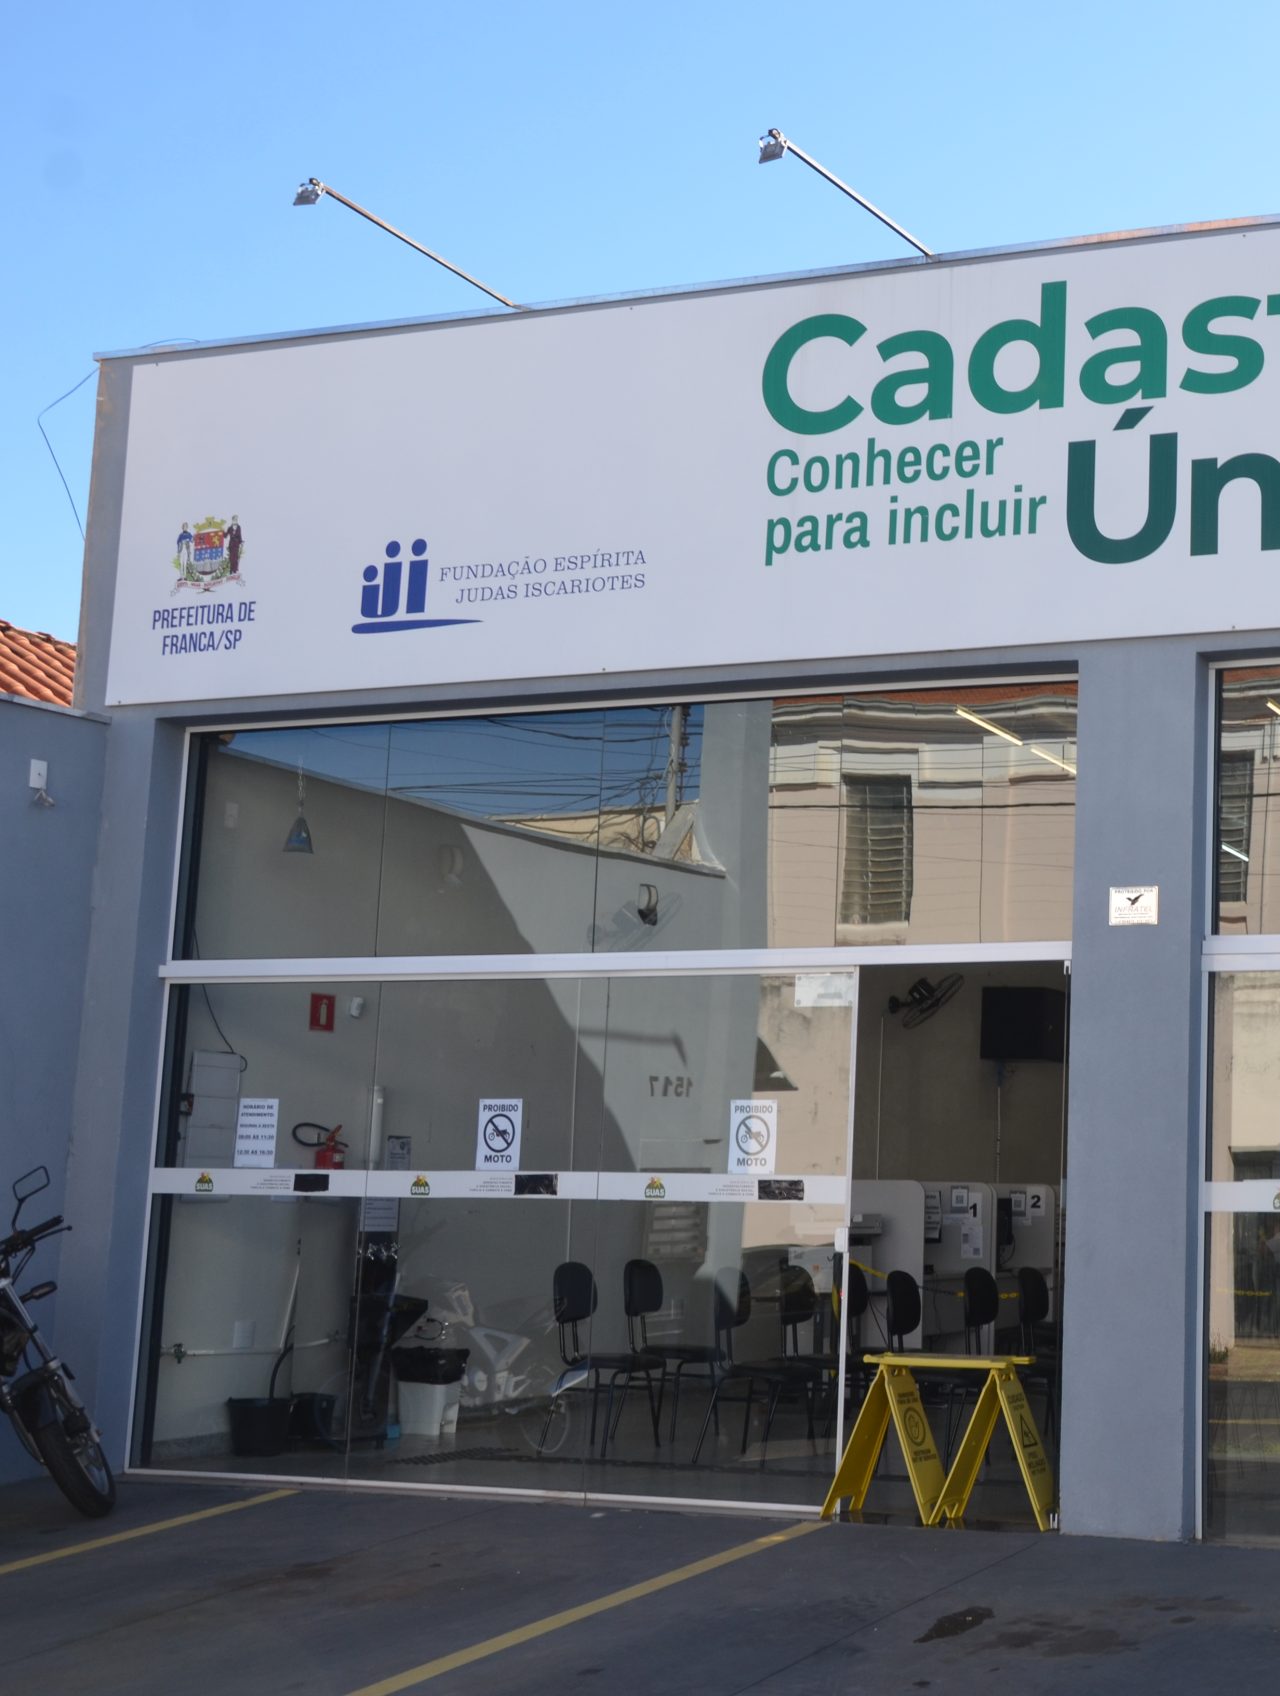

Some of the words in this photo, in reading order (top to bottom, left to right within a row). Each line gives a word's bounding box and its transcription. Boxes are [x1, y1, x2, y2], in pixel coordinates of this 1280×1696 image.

[766, 436, 1004, 497] Conhecer
[765, 510, 871, 567] para
[887, 484, 1047, 545] incluir
[439, 556, 547, 582] FUNDAÇÃO
[553, 548, 647, 572] ESPÍRITA
[455, 584, 518, 604] JUDAS
[524, 573, 646, 598] ISCARIOTES
[152, 603, 234, 630] PREFEITURA
[237, 601, 257, 622] DE
[162, 629, 242, 656] FRANCA/SP
[483, 1104, 519, 1112] PROIBIDO
[734, 1104, 773, 1114] PROIBIDO
[484, 1154, 512, 1163] MOTO
[736, 1157, 767, 1167] MOTO
[645, 1188, 666, 1196] SUAS
[1030, 1194, 1041, 1209] 2
[969, 1203, 978, 1218] 1
